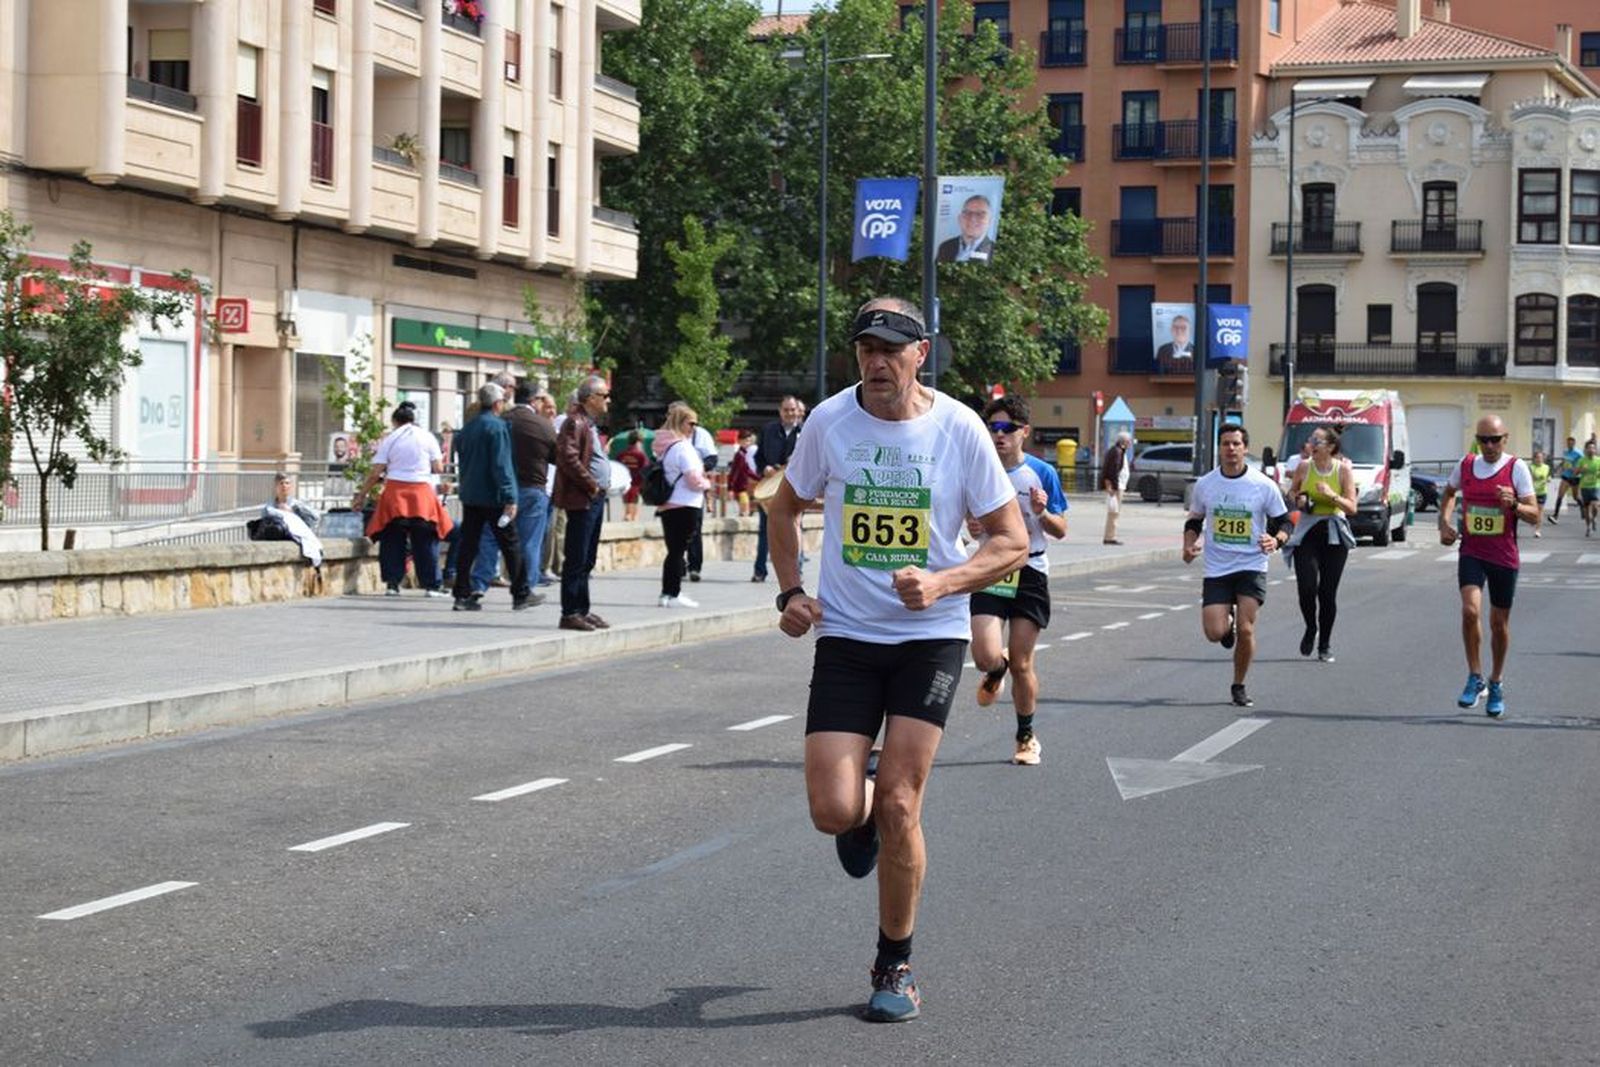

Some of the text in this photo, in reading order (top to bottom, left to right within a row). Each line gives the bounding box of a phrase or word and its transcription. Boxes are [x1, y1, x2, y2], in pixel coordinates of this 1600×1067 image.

[865, 199, 902, 211] VOTA
[1216, 318, 1243, 327] VOTA
[868, 497, 919, 507] CAJA RURAL
[851, 512, 919, 546] 653
[1218, 519, 1246, 534] 218
[1473, 517, 1494, 532] 89
[865, 552, 922, 563] CAJA RURAL
